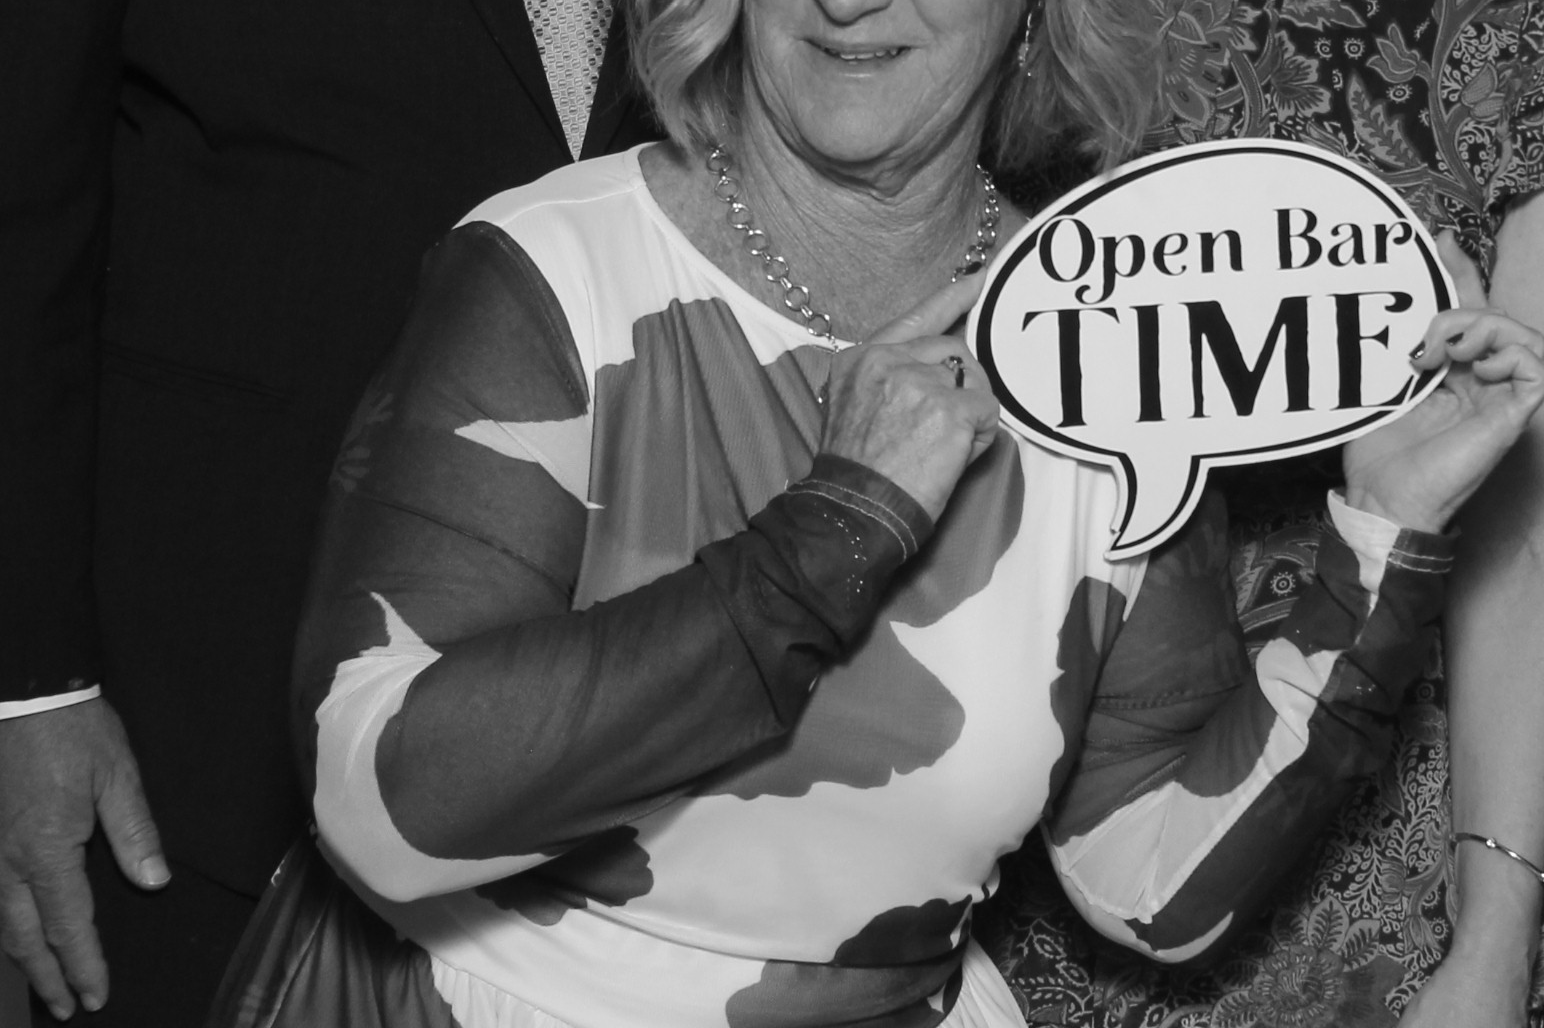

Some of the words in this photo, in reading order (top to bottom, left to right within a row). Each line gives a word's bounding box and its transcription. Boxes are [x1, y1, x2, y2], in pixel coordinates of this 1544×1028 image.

[1038, 217, 1244, 305] Open
[1273, 208, 1413, 270] Bar
[1021, 291, 1415, 428] TIME
